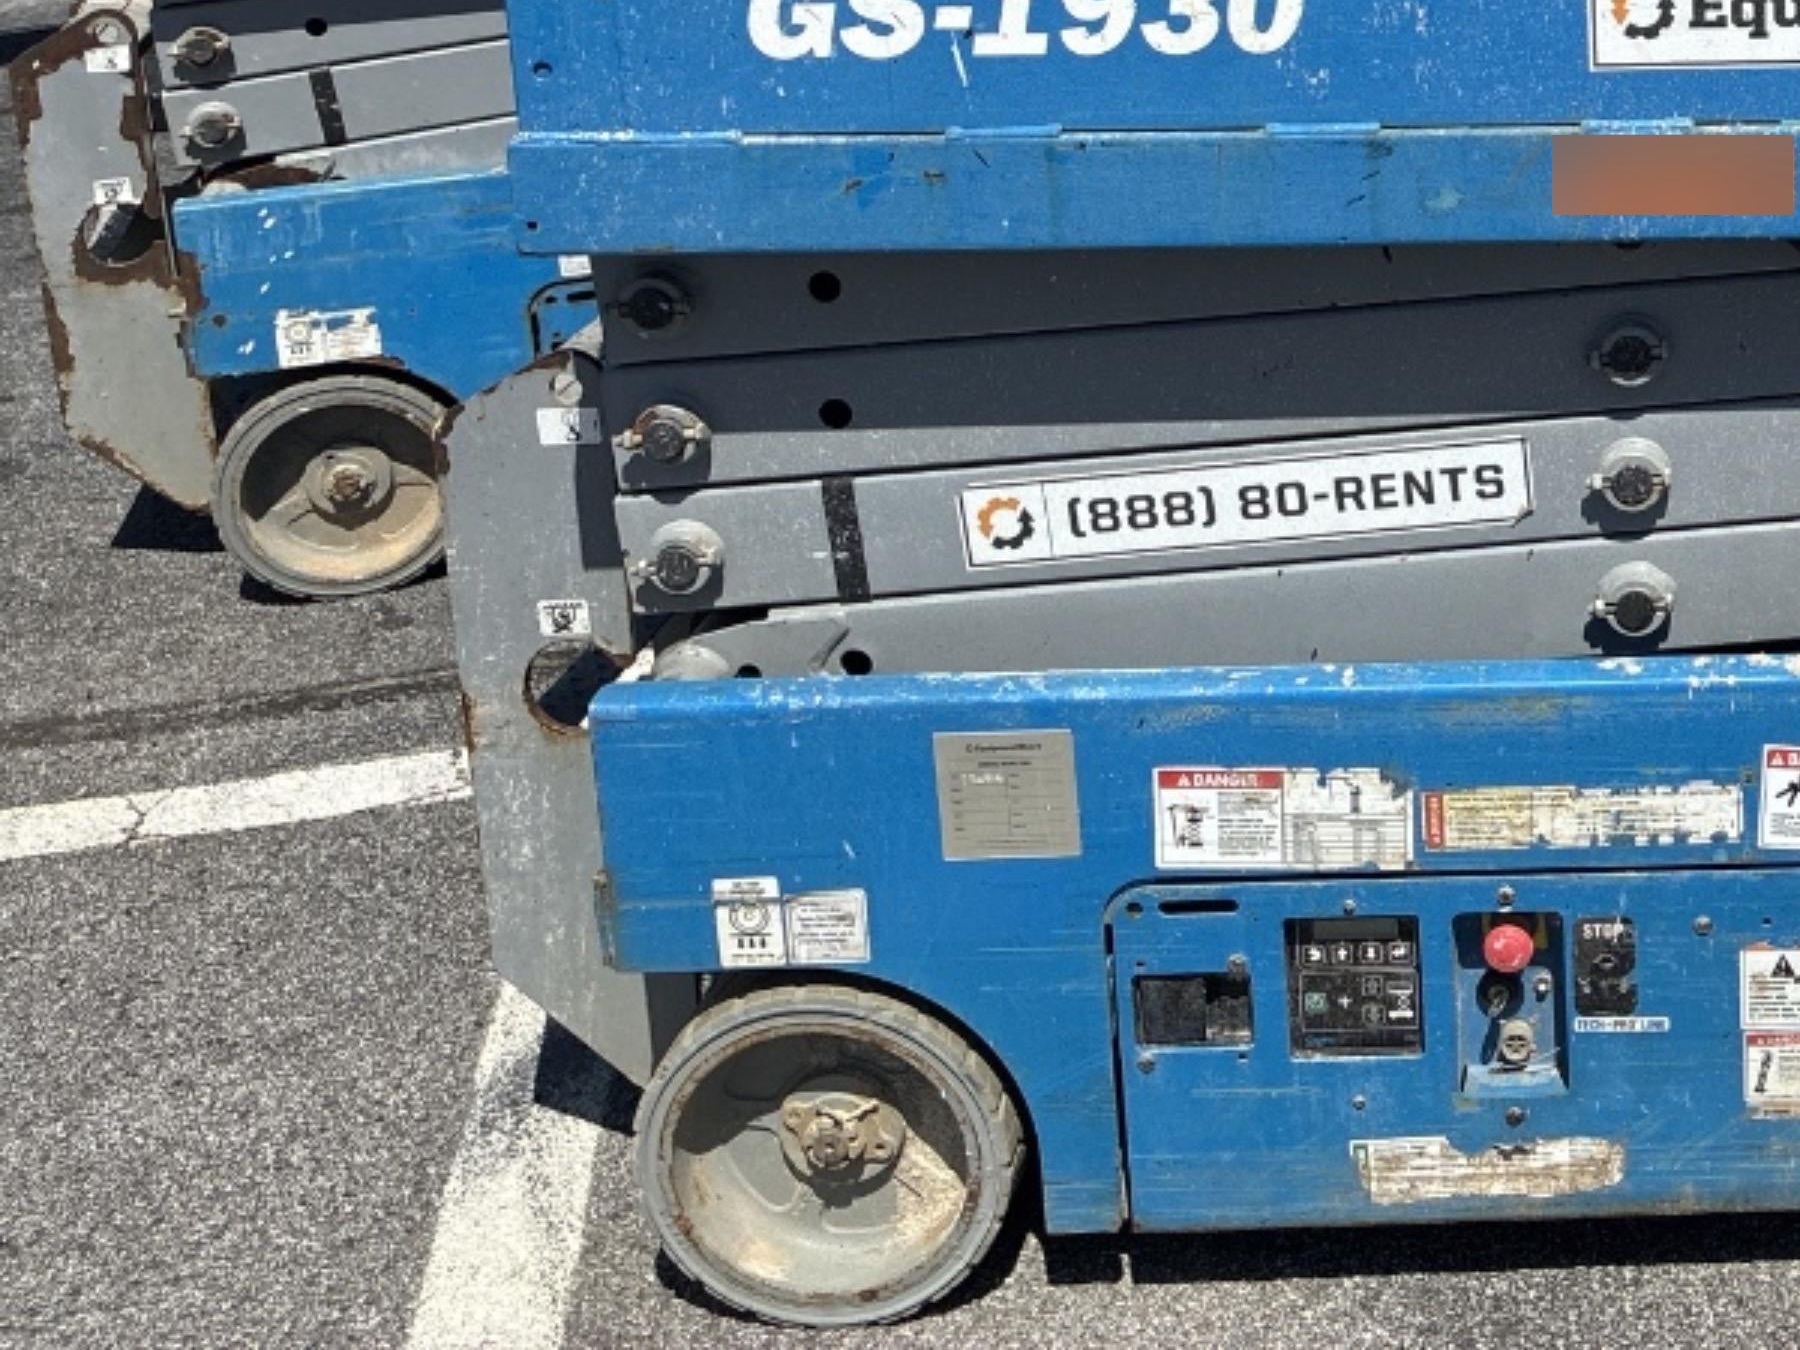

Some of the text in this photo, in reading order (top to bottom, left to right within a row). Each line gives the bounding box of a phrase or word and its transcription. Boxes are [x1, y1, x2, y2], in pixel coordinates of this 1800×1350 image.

[1067, 463, 1506, 538] (888) 80-RENTS
[1193, 772, 1259, 788] DANGER
